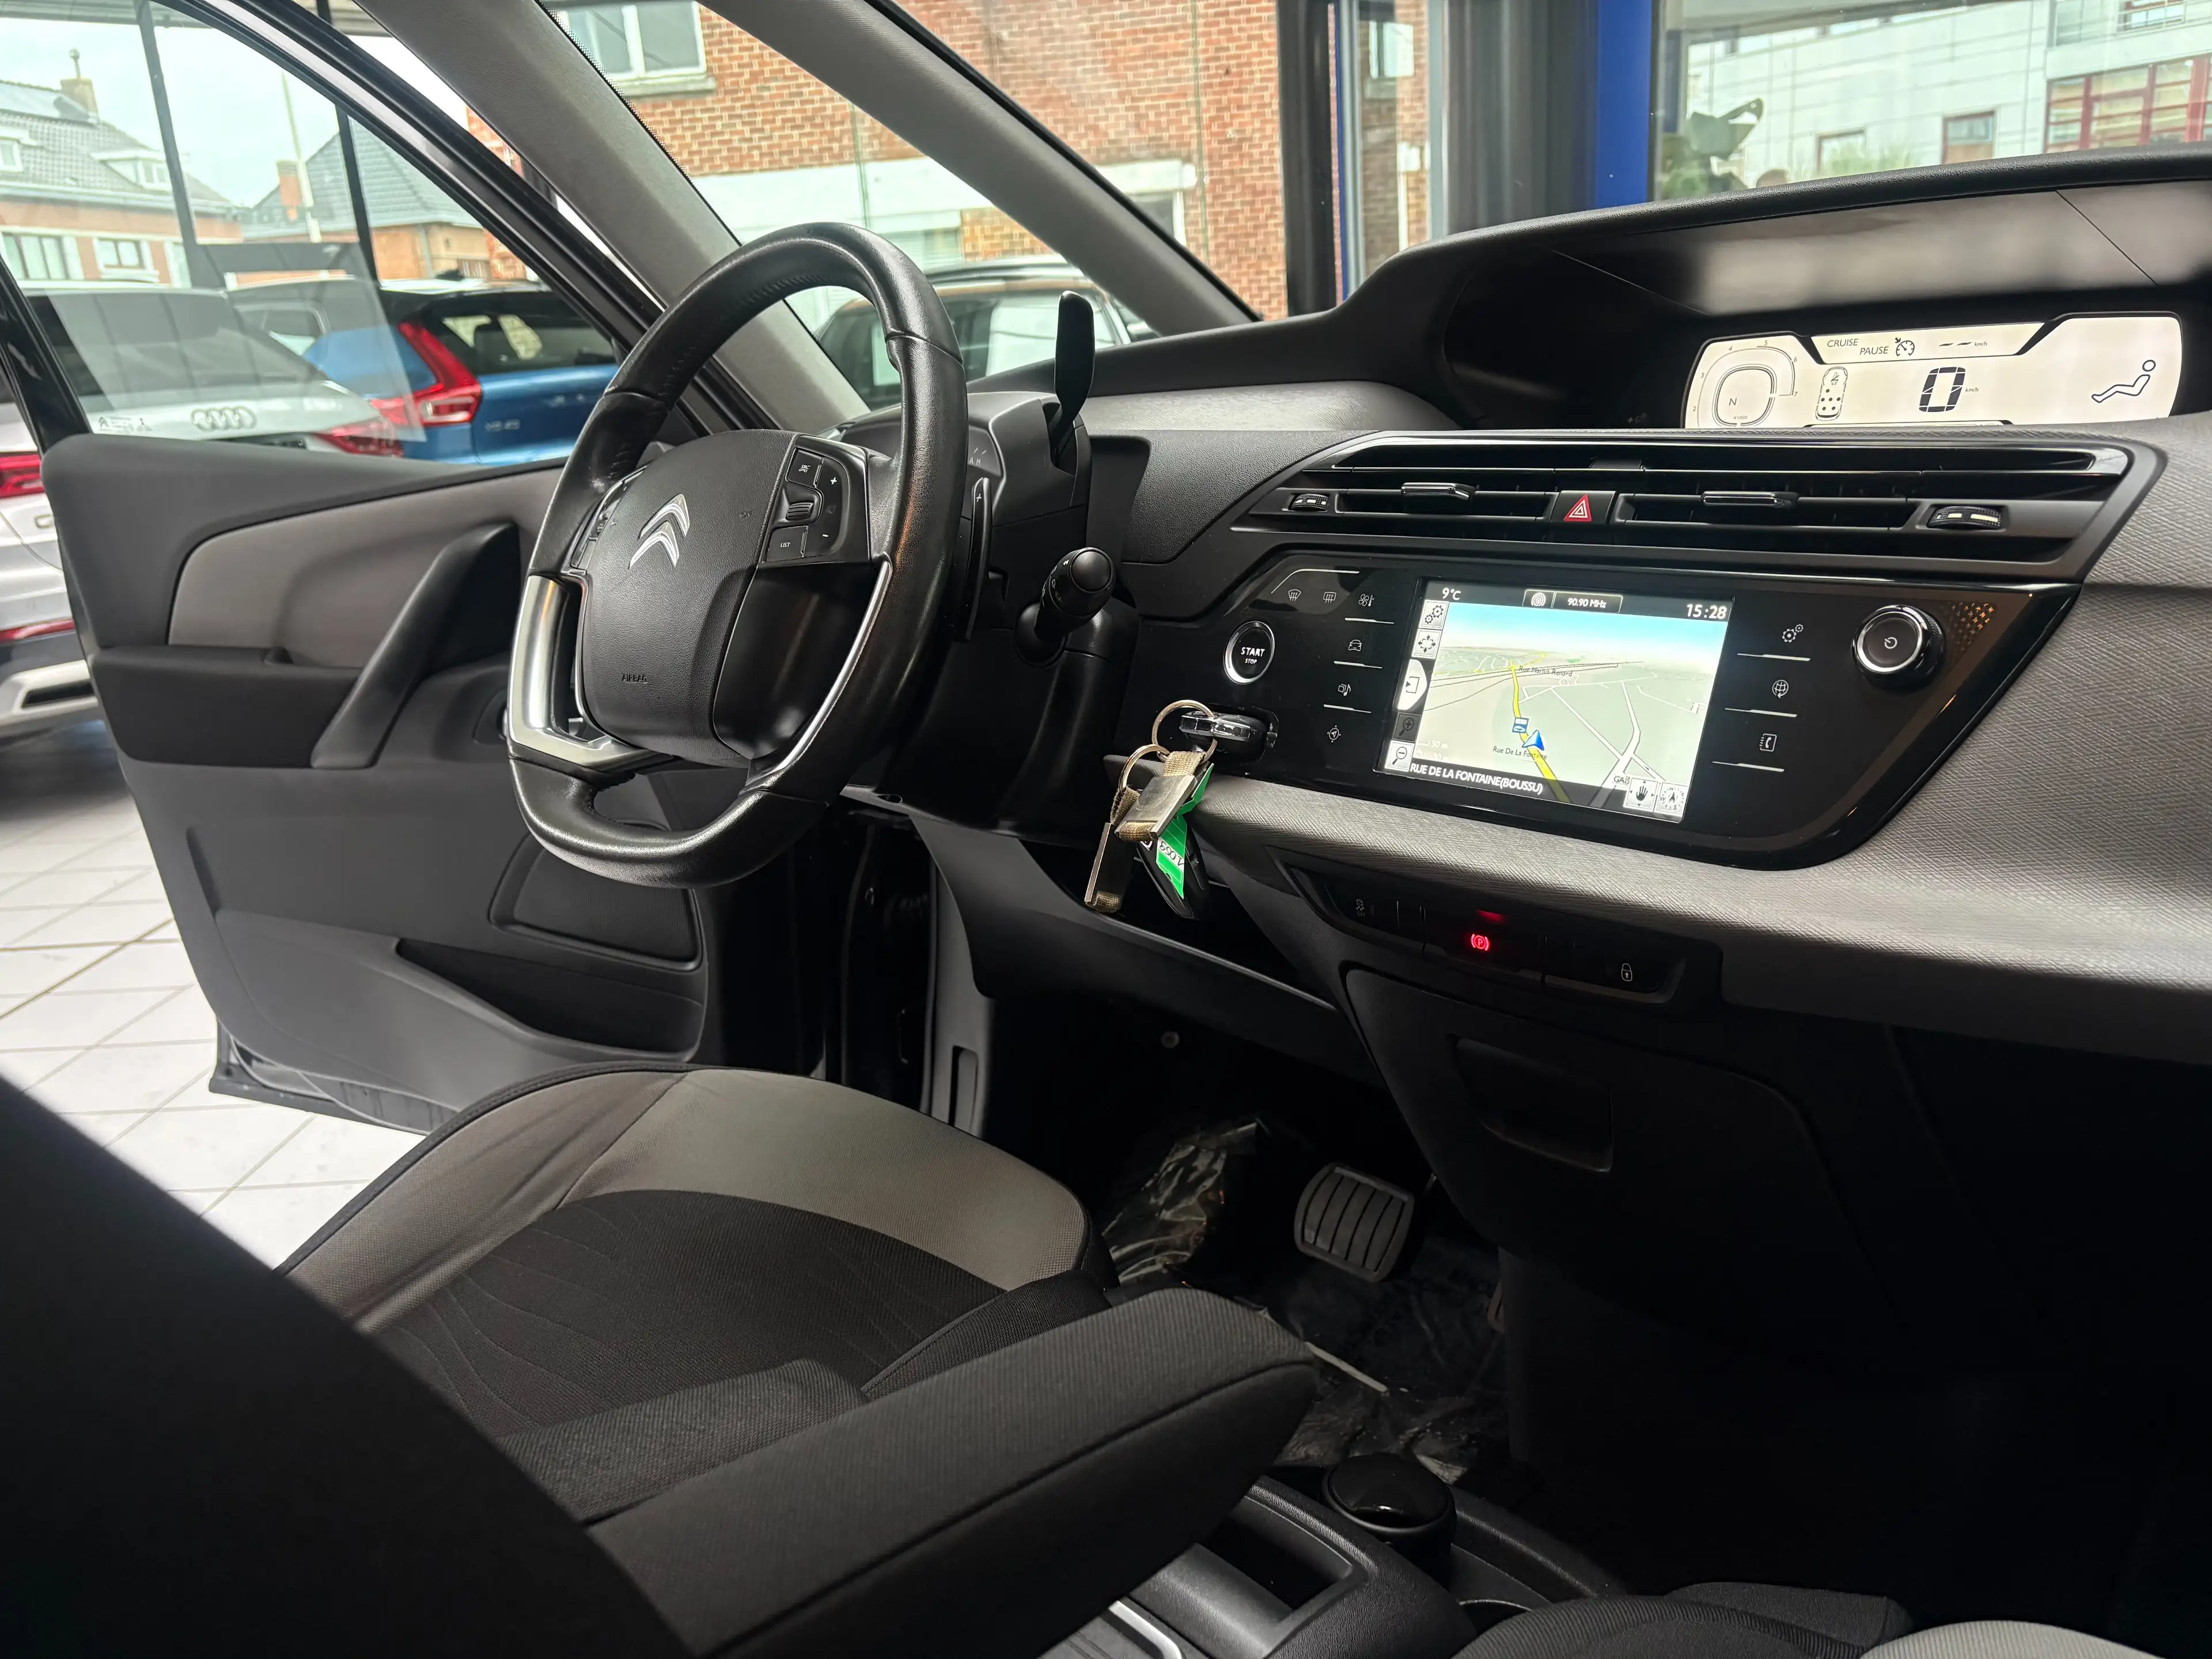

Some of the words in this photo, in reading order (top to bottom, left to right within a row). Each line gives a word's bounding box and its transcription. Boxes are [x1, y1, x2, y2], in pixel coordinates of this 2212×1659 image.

[1827, 338, 1858, 347] CRUISE
[1859, 346, 1889, 355] PAUSE
[1919, 366, 1965, 412] 0
[1729, 397, 1737, 406] N
[1442, 588, 1461, 601] 9°C
[1567, 597, 1589, 607] 90.90
[1589, 600, 1607, 608] MHz
[1687, 604, 1728, 620] 15:28
[1240, 646, 1266, 657] START
[1551, 668, 1573, 677] Renard
[1523, 750, 1547, 760] Fontaine
[1410, 763, 1427, 774] RUE
[1428, 766, 1442, 777] DE
[1442, 768, 1454, 779] LA
[1455, 770, 1543, 795] FONTAINE(BOUSSU)
